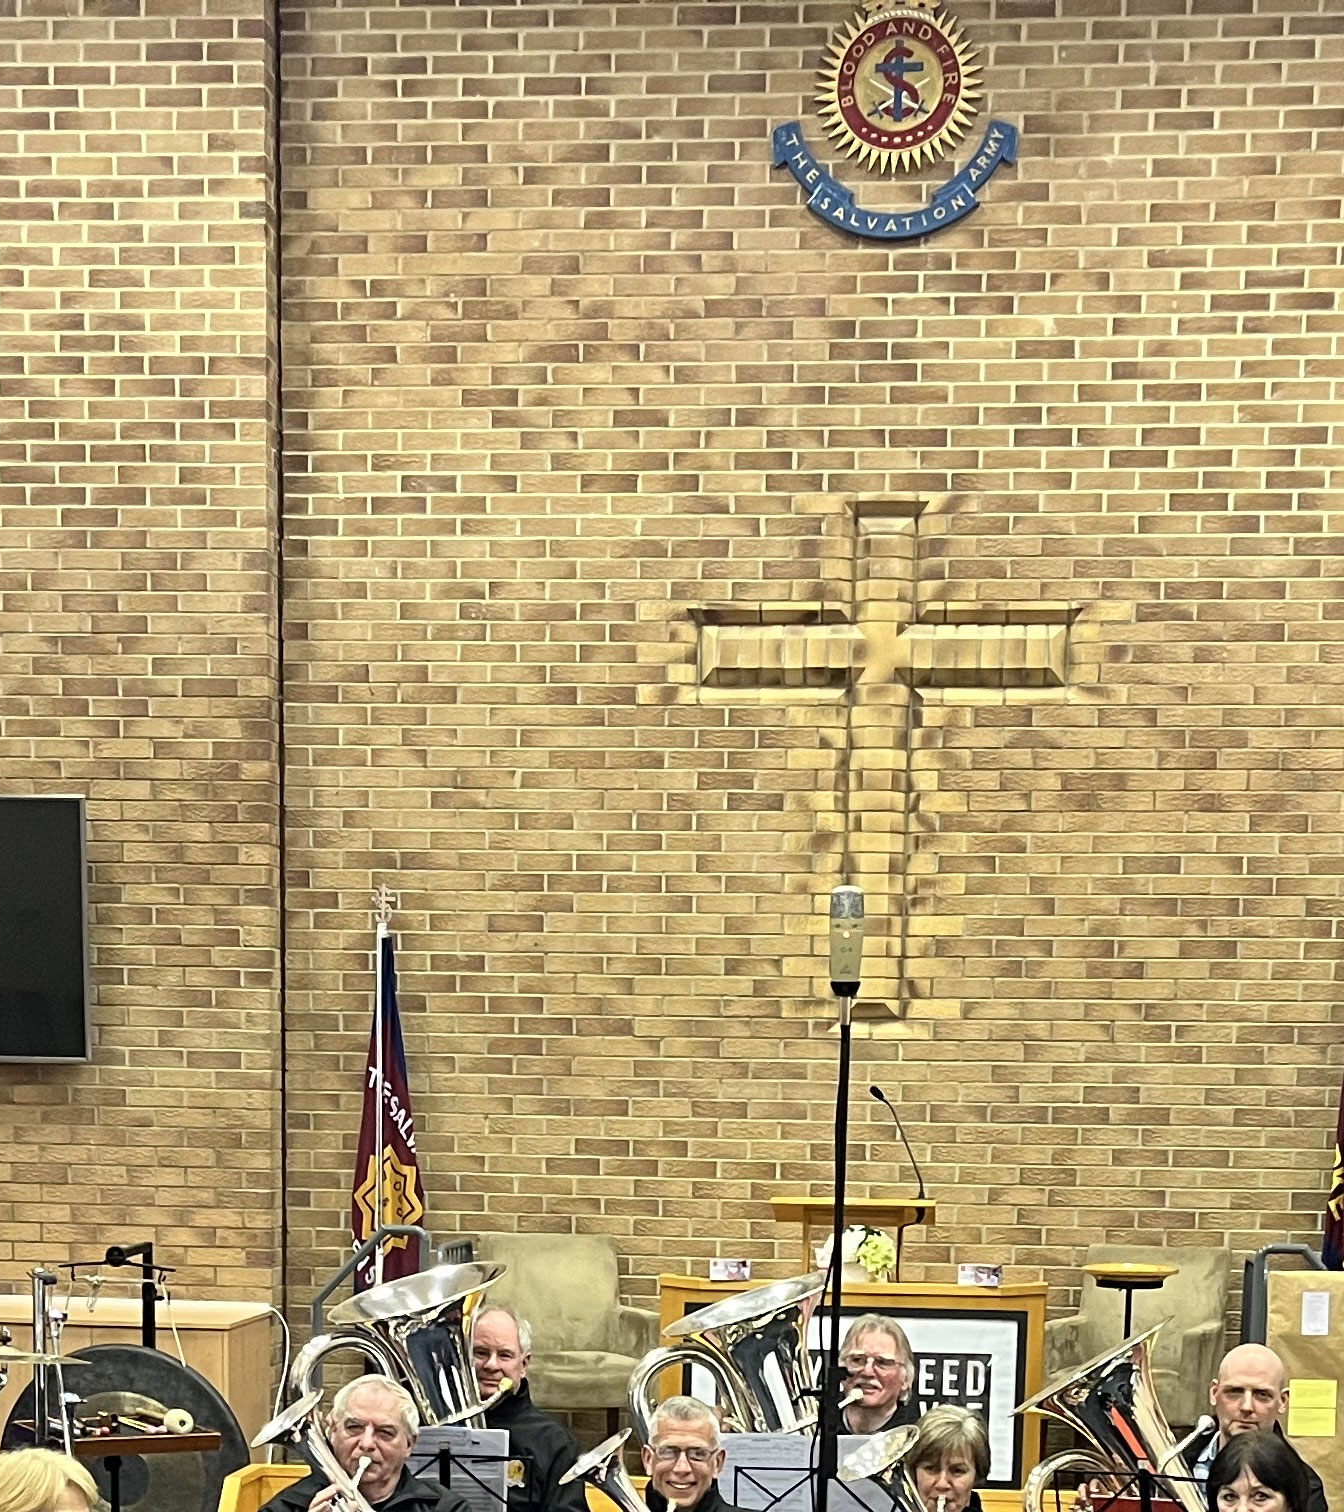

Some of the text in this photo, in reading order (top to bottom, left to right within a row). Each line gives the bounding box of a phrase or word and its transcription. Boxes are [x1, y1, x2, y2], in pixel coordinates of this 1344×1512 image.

[840, 21, 958, 107] BLOOD AND FIRE
[786, 128, 1005, 232] THE SALVATION ARMY
[918, 1358, 986, 1397] EED
